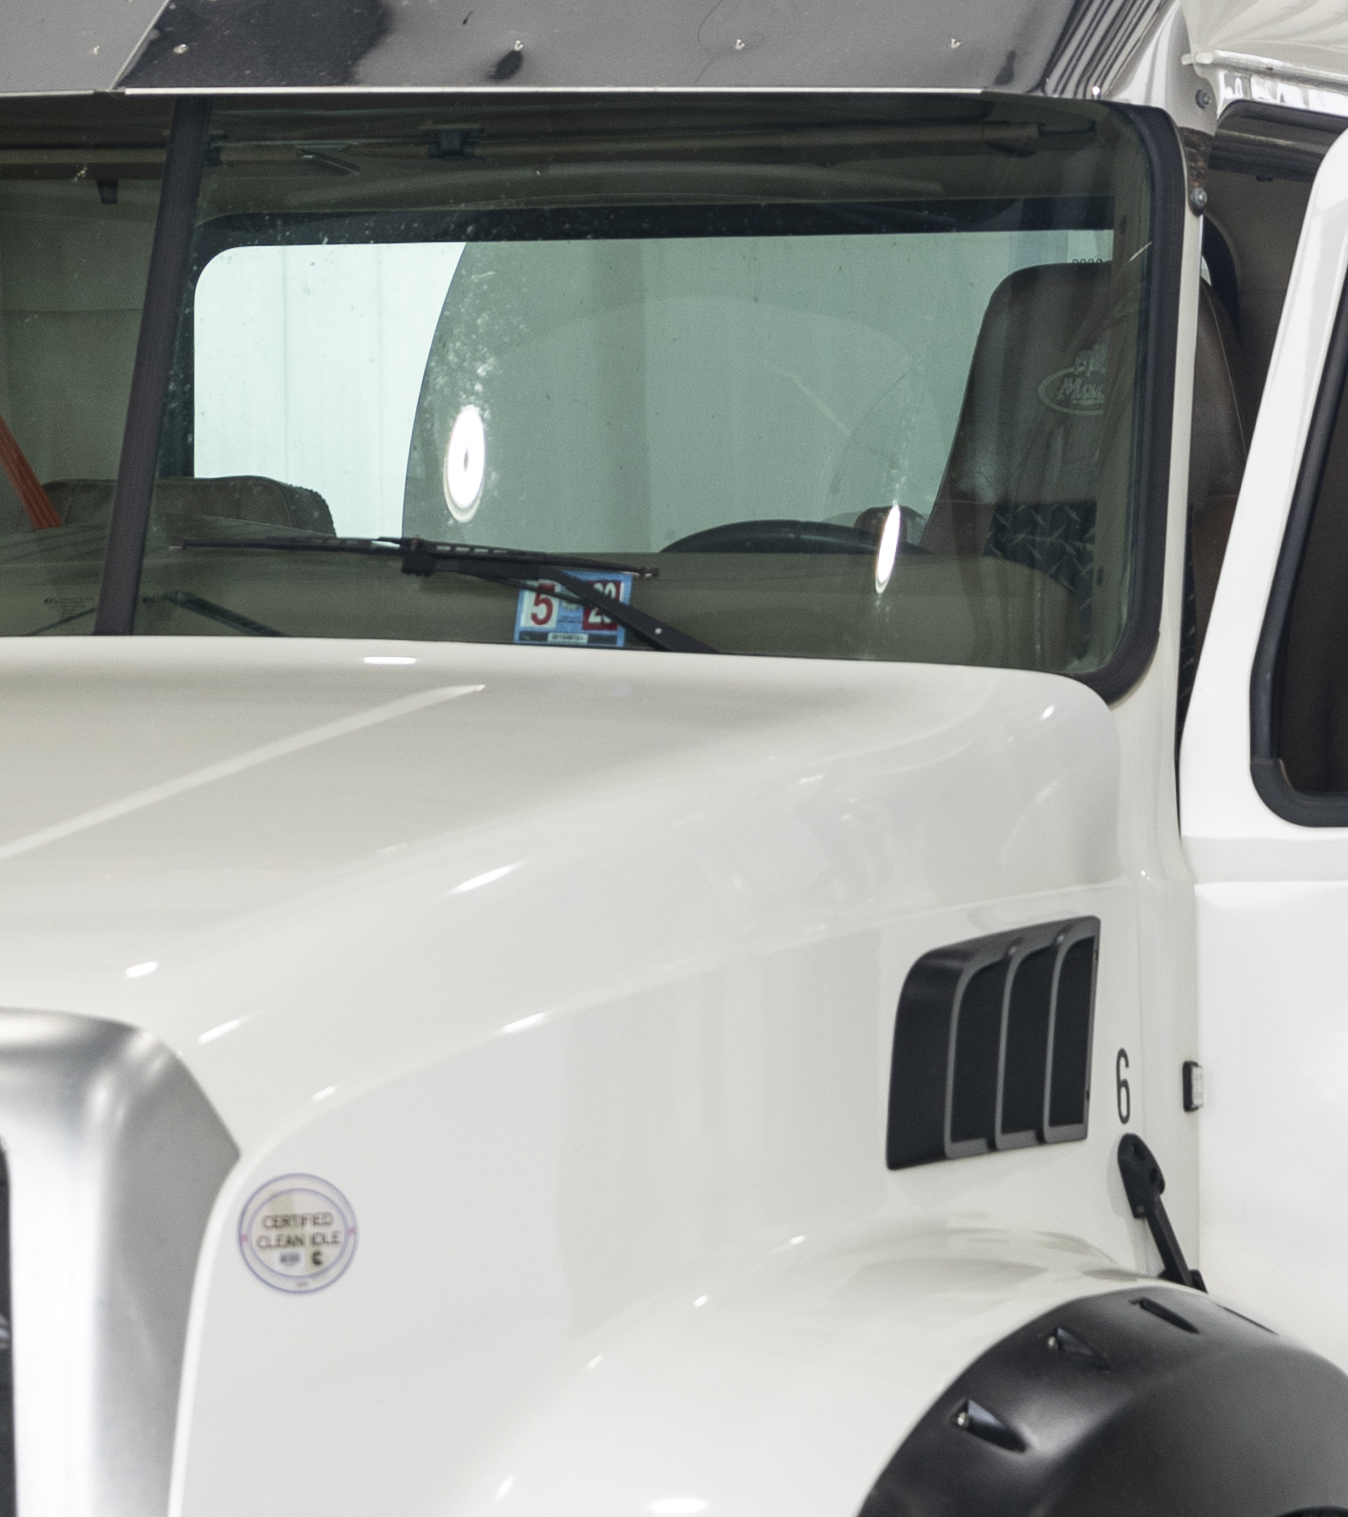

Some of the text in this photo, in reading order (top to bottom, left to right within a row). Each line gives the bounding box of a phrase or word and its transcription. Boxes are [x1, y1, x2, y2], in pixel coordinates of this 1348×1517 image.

[530, 583, 555, 626] 5
[1116, 1047, 1131, 1124] 6
[262, 1212, 334, 1229] CERTIFIED
[256, 1231, 342, 1249] CLEAN IDLE
